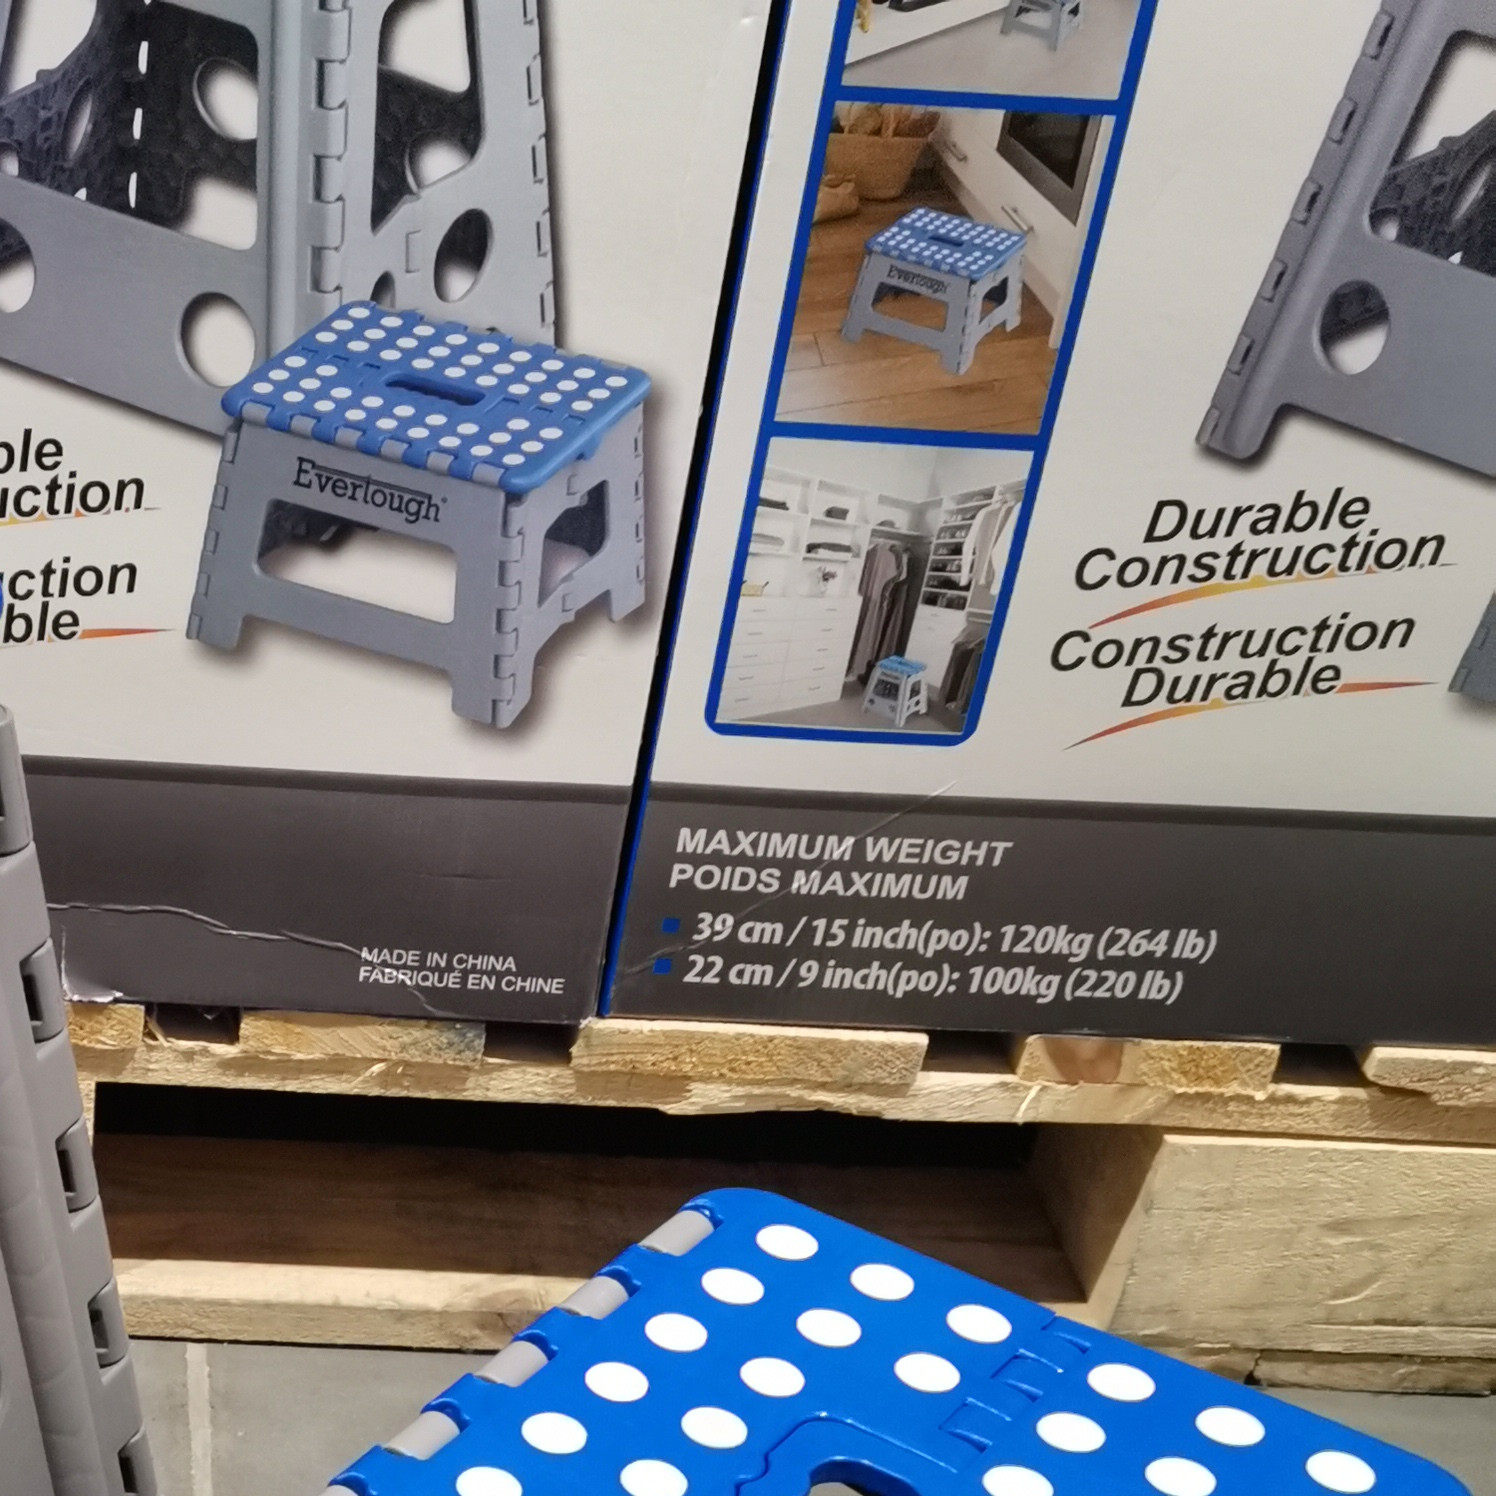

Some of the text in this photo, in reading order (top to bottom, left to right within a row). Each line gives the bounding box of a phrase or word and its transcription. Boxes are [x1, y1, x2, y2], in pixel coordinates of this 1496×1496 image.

[1143, 486, 1371, 543] Durable
[1074, 528, 1446, 591] Construction
[1050, 612, 1416, 672] Construction
[1121, 656, 1342, 708] Durable
[676, 827, 1013, 868] MAXIMUM WEIGHT
[668, 863, 969, 901] POIDS MAXIMUM
[361, 946, 517, 973] MADE IN CHINA
[692, 912, 1218, 963] 39 cm / 15 inch(po): 120kg (264 lb)
[358, 966, 566, 995] FABRIQUÉ EN CHINE
[682, 954, 1184, 1005] 22 cm / 9 inch(po): 100kg (220 lb)
